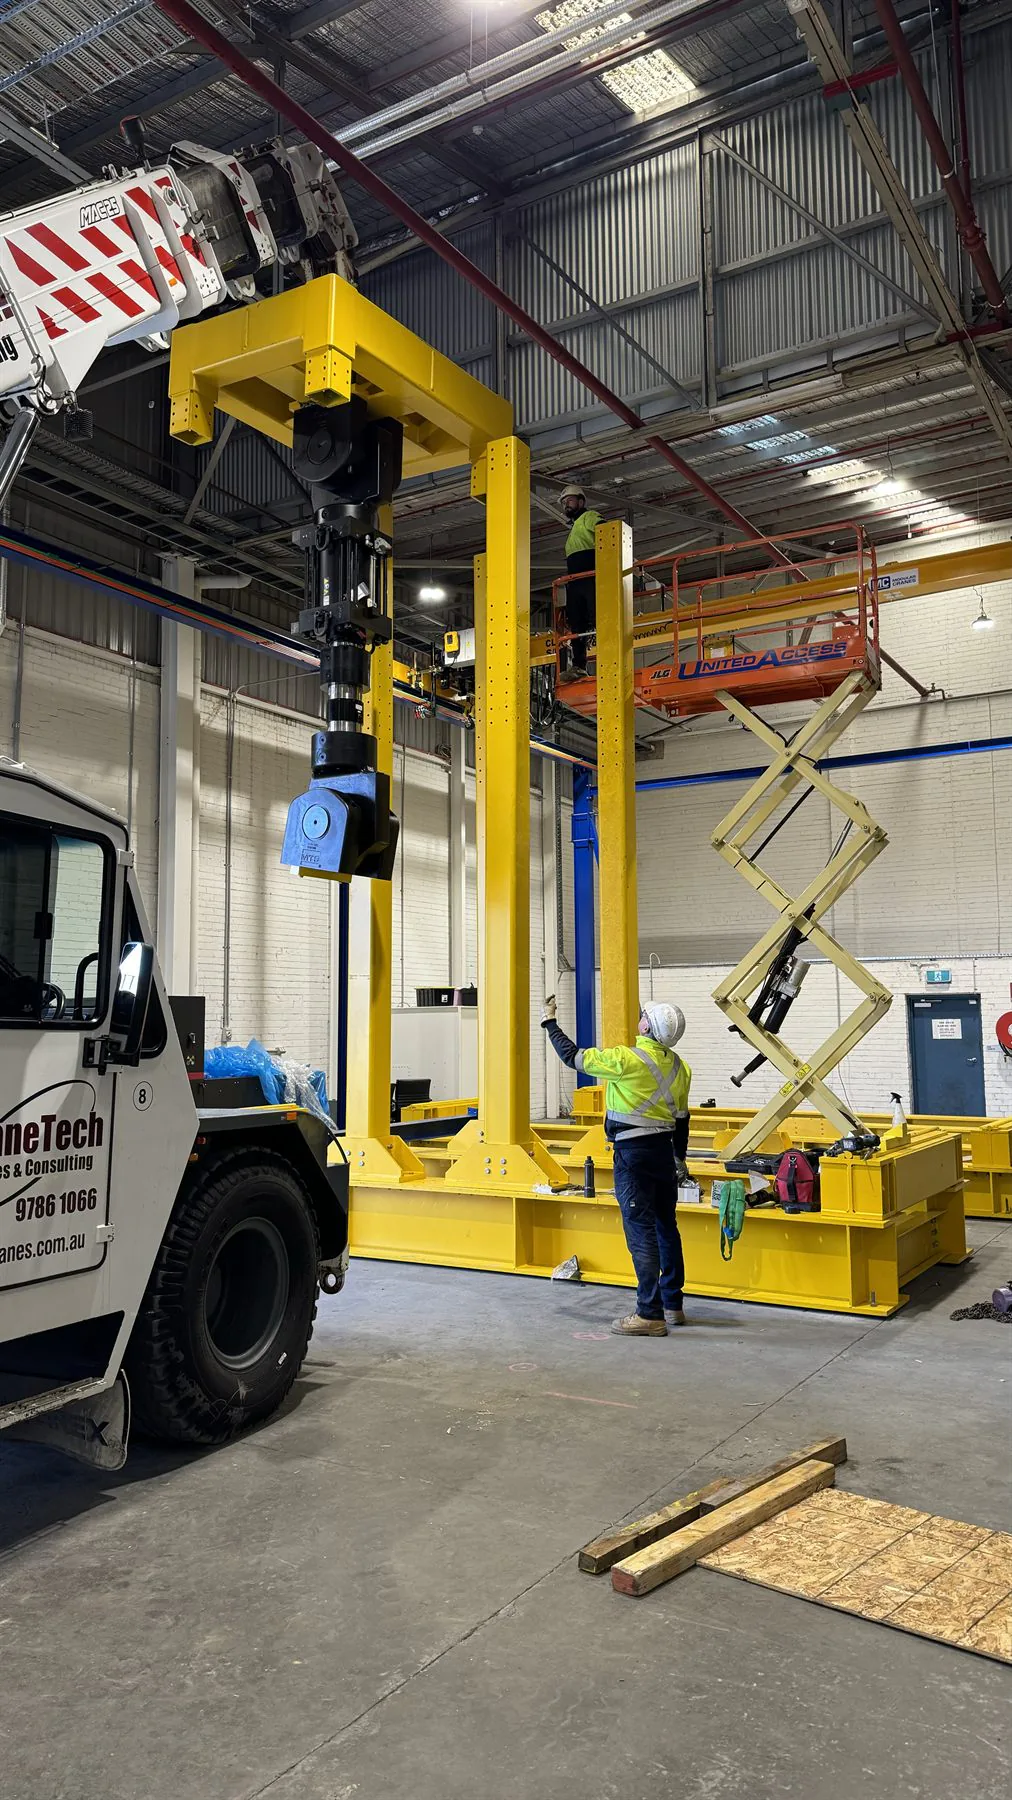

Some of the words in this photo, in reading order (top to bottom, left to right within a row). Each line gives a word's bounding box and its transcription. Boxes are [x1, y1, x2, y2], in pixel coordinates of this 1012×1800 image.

[892, 579, 917, 587] CRANES
[678, 655, 757, 680] UNITED
[757, 641, 848, 667] ACCESS
[650, 669, 671, 679] JLG
[138, 1089, 147, 1104] 8
[0, 1111, 104, 1157] neTech
[13, 1162, 22, 1178] &
[25, 1154, 94, 1176] Consulting
[15, 1193, 56, 1222] 9786
[59, 1187, 98, 1215] 1066
